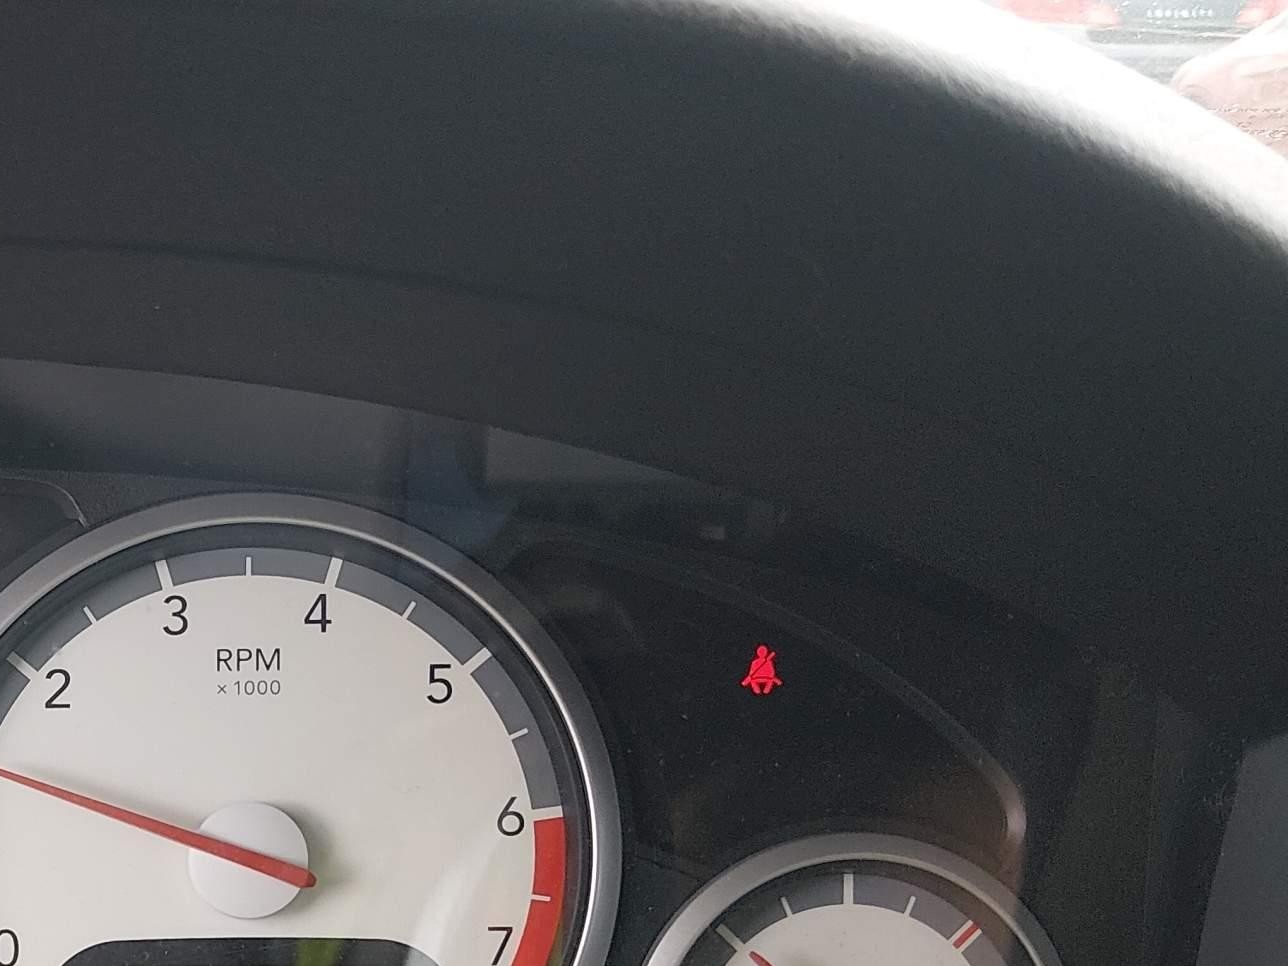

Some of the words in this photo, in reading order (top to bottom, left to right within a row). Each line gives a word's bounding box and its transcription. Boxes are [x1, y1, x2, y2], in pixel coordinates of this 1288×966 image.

[163, 595, 188, 635] 3
[304, 594, 332, 632] 4
[217, 648, 280, 671] RPM
[45, 669, 70, 708] 2
[234, 680, 280, 695] 1000
[427, 664, 452, 704] 5
[497, 797, 524, 836] 6
[488, 928, 513, 966] 7
